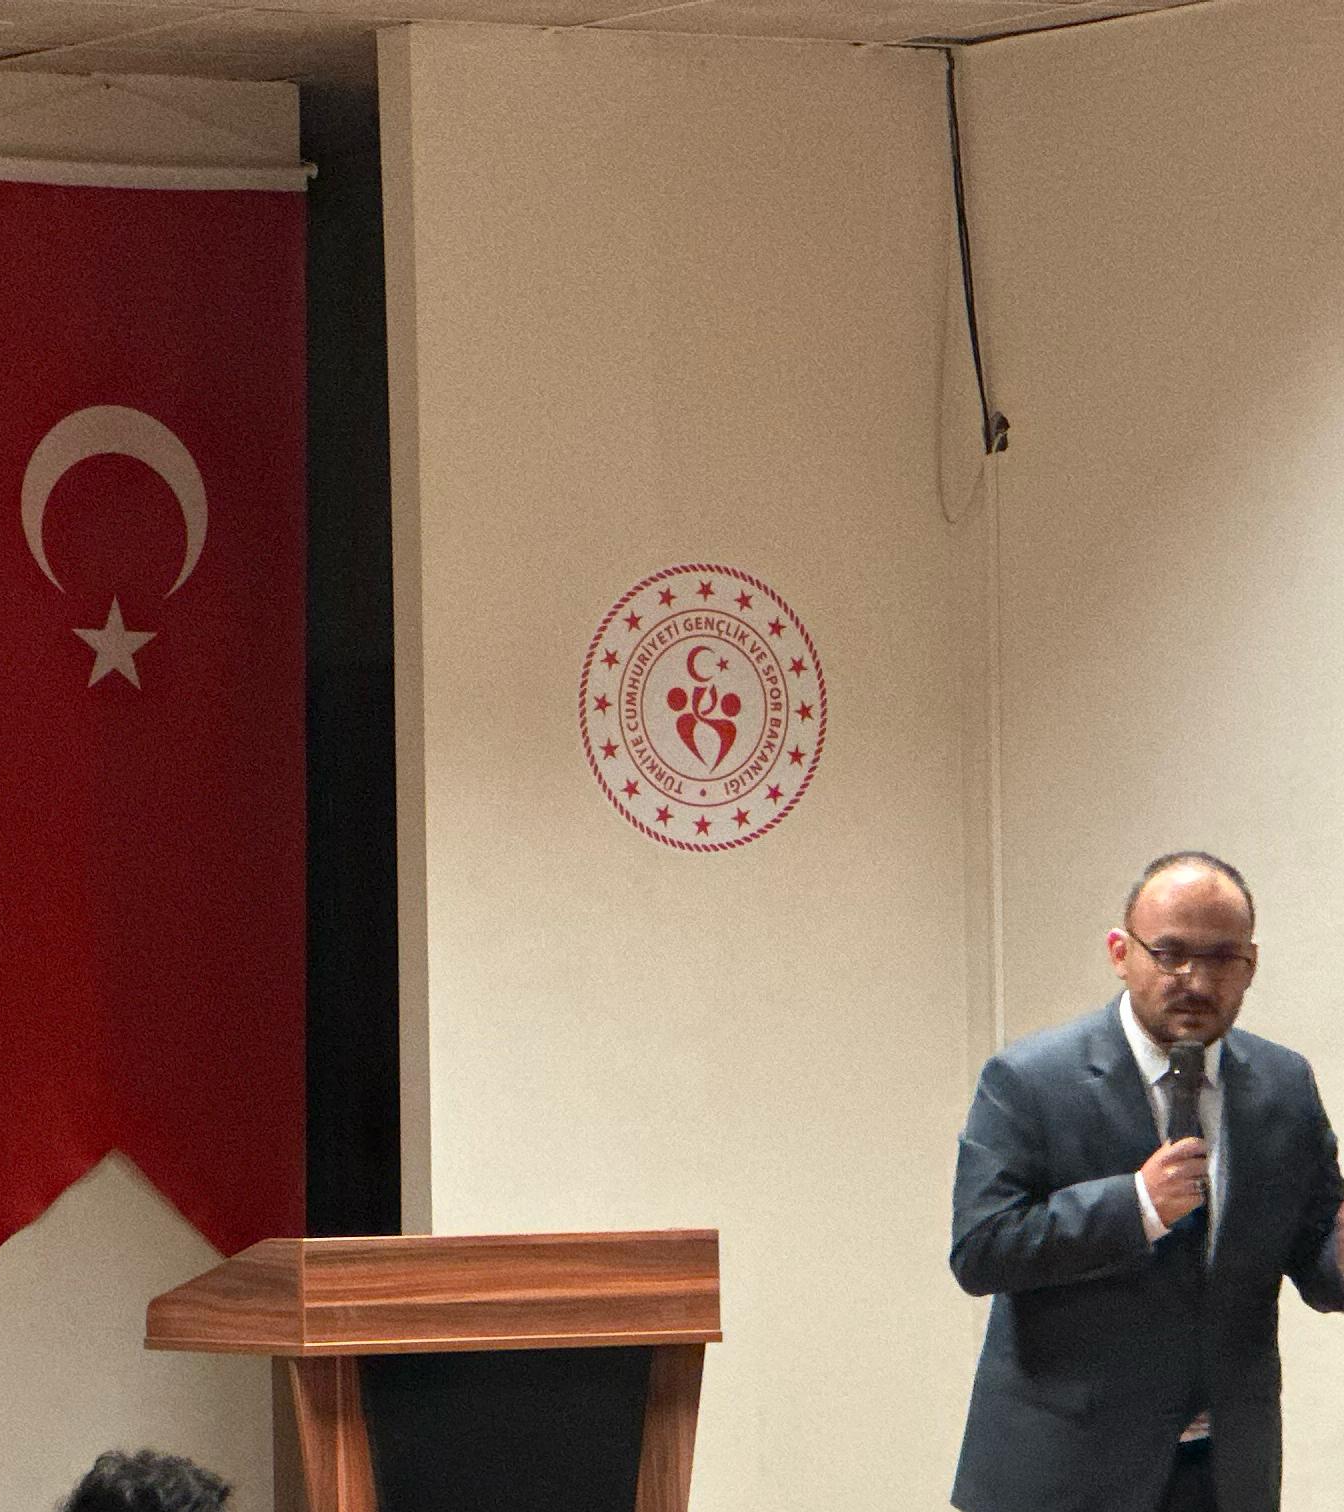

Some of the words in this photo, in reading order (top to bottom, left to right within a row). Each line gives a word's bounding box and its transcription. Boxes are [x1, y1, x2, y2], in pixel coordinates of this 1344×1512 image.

[683, 616, 750, 647] GENÇLİK
[748, 640, 768, 665] VE
[626, 622, 681, 731] CUMHURİYETİ
[761, 664, 784, 713] SPOR
[630, 736, 684, 796] TÜRKİYE
[723, 719, 782, 796] BAKANLIĞI
